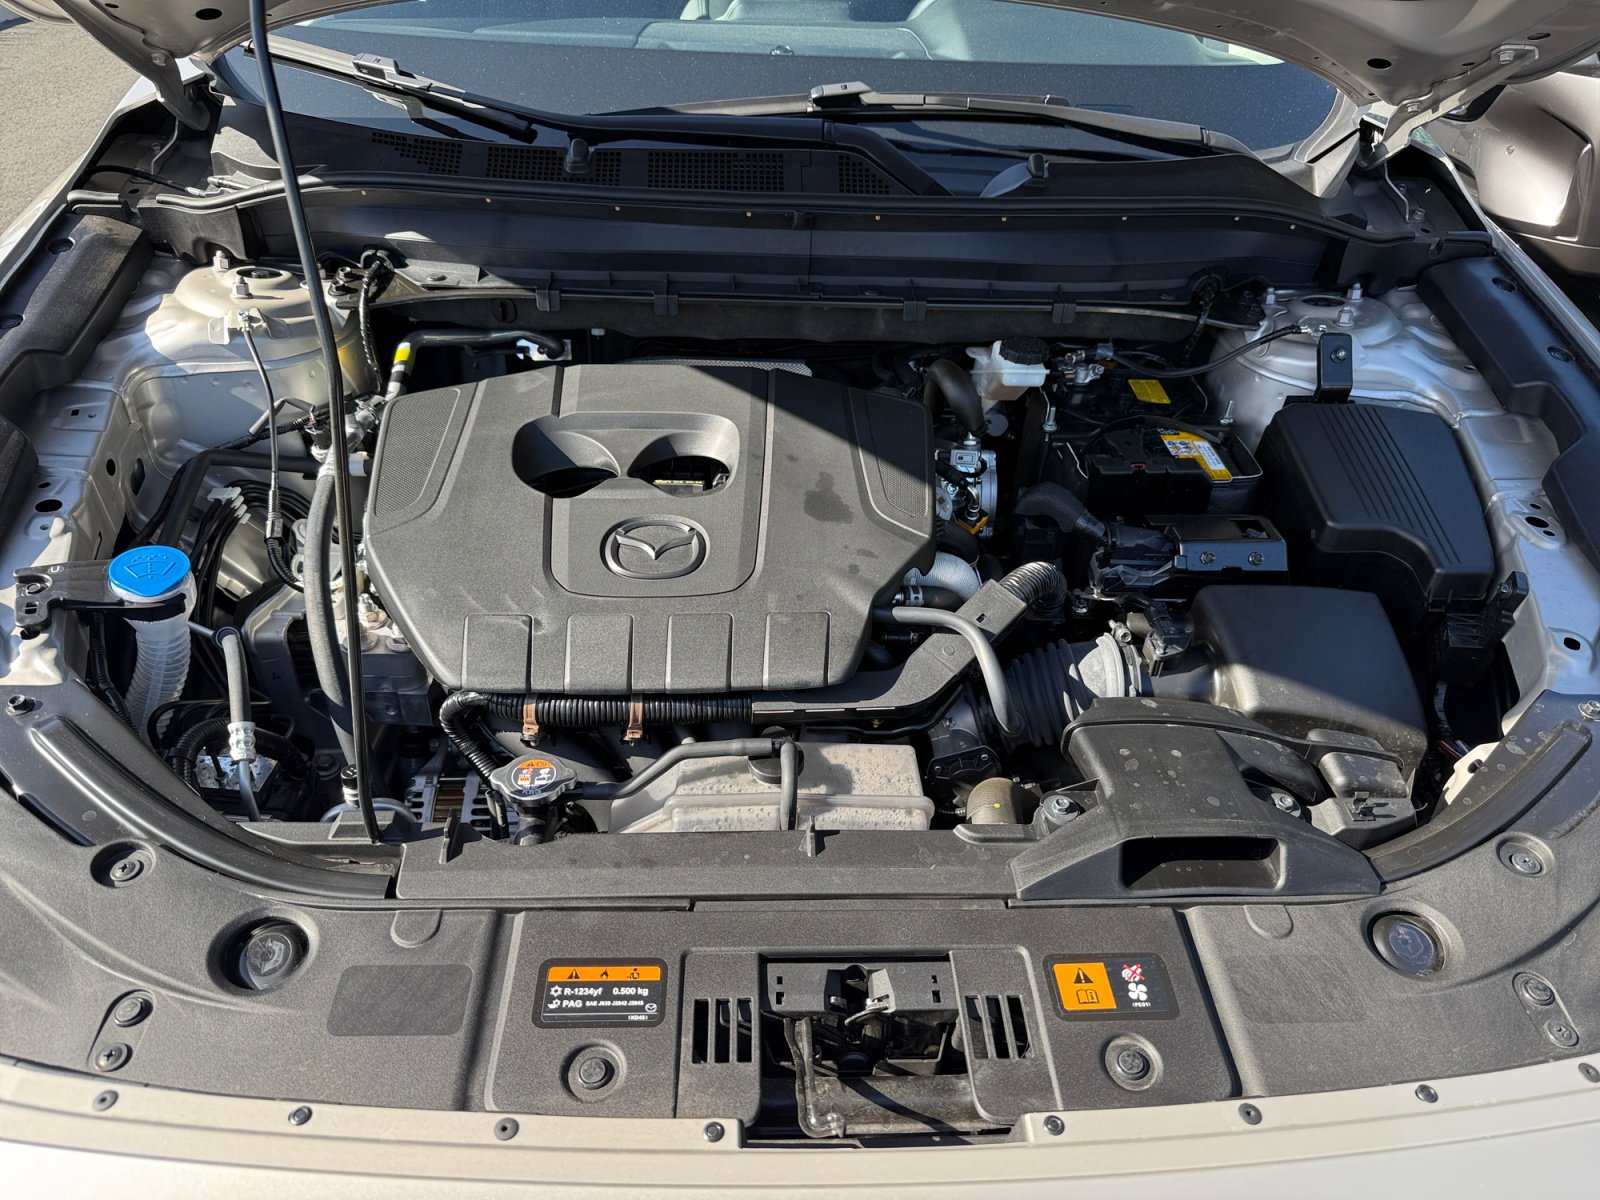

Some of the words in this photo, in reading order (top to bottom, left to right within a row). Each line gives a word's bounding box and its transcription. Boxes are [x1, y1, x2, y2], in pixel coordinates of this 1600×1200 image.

[564, 987, 603, 996] R-1234yf
[613, 987, 636, 995] 0.500
[637, 987, 649, 996] kg
[562, 999, 583, 1008] PAG
